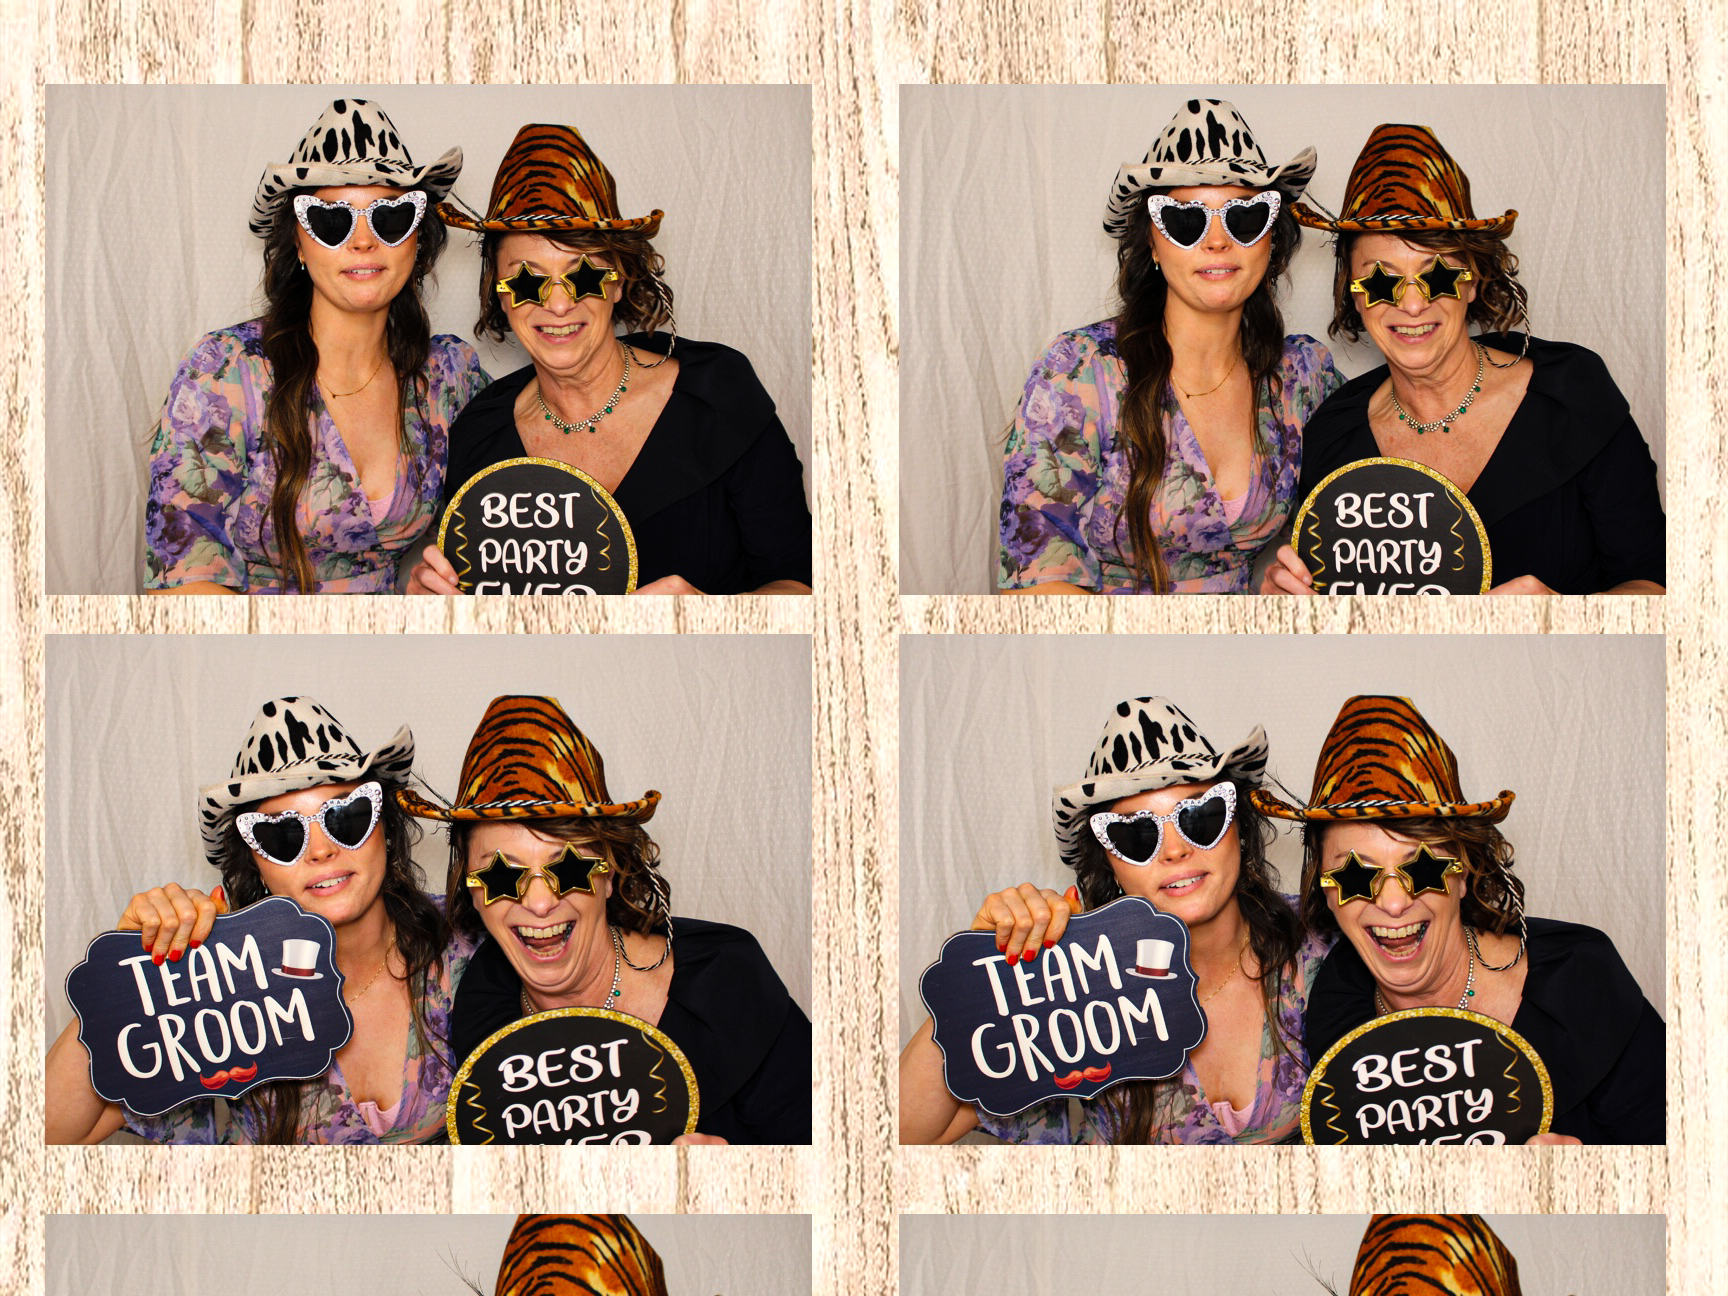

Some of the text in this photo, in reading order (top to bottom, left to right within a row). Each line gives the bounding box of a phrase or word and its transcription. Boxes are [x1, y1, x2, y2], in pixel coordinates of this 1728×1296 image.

[480, 492, 581, 529] BEST
[1334, 492, 1435, 529] BEST
[478, 538, 588, 575] PARTY
[1332, 538, 1442, 575] PARTY
[238, 784, 369, 823] JUST MARRIED
[1092, 784, 1223, 823] JUST MARRIED
[118, 934, 269, 1017] TEAM
[972, 934, 1123, 1017] TEAM
[117, 988, 316, 1082] GROOM
[971, 988, 1170, 1082] GROOM
[498, 1038, 629, 1093] BEST
[1352, 1038, 1483, 1093] BEST
[501, 1088, 640, 1139] PARTY
[1355, 1088, 1494, 1139] PARTY
